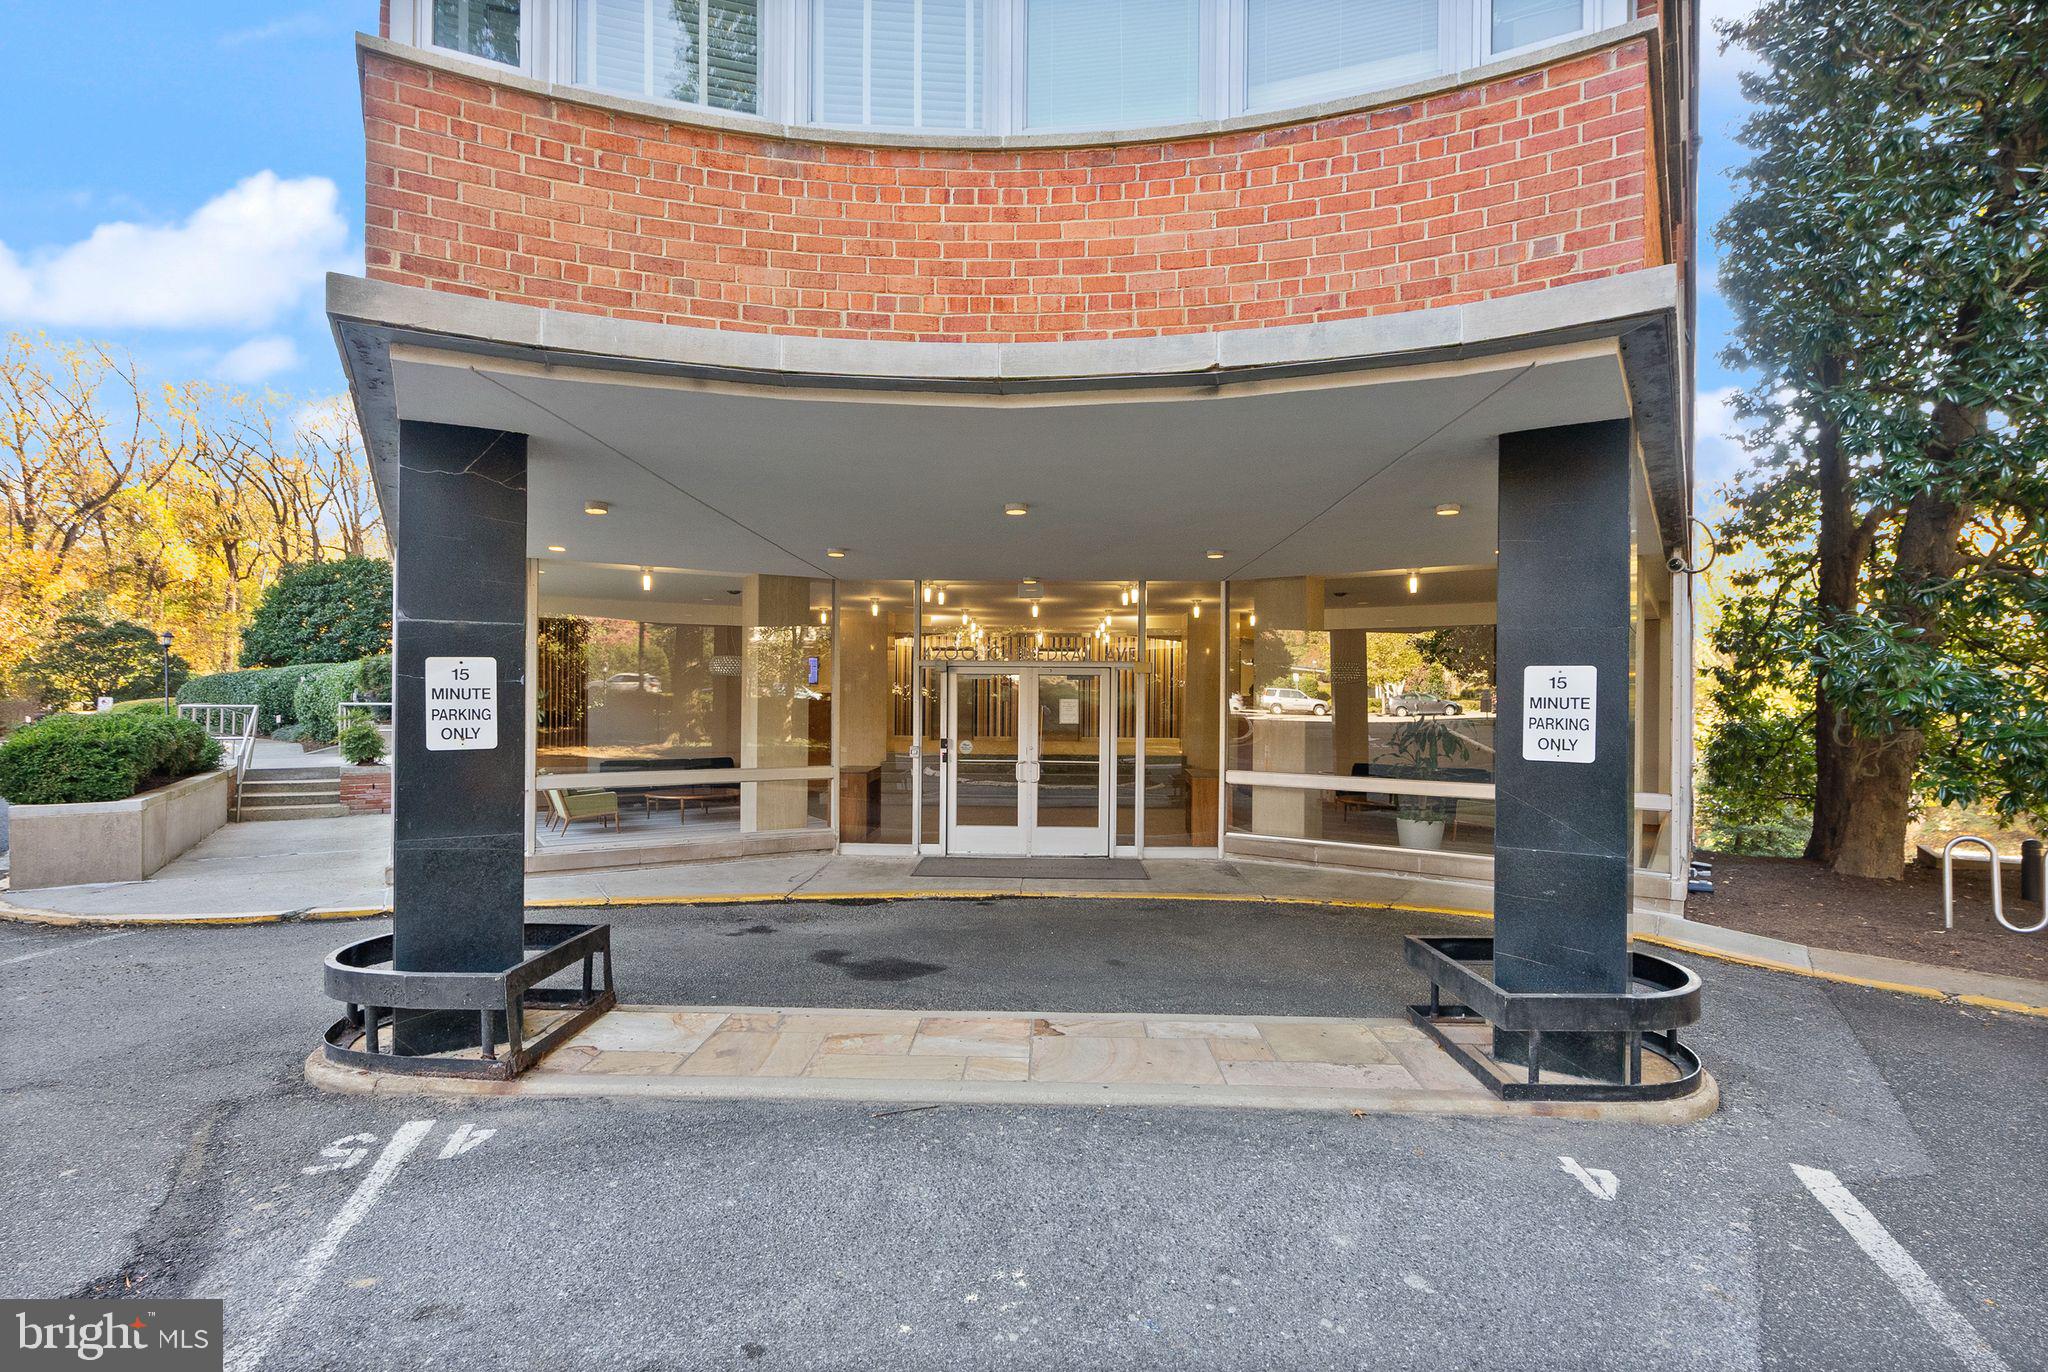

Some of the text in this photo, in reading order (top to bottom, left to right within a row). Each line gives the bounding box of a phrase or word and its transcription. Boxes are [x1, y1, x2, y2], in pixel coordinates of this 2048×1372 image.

[452, 668, 470, 681] 15
[1549, 676, 1567, 690] 15
[431, 687, 491, 700] MINUTE
[1529, 696, 1591, 710] MINUTE
[431, 708, 492, 721] PARKING
[1528, 716, 1590, 731] PARKING
[441, 727, 481, 740] ONLY
[1537, 737, 1579, 752] ONLY
